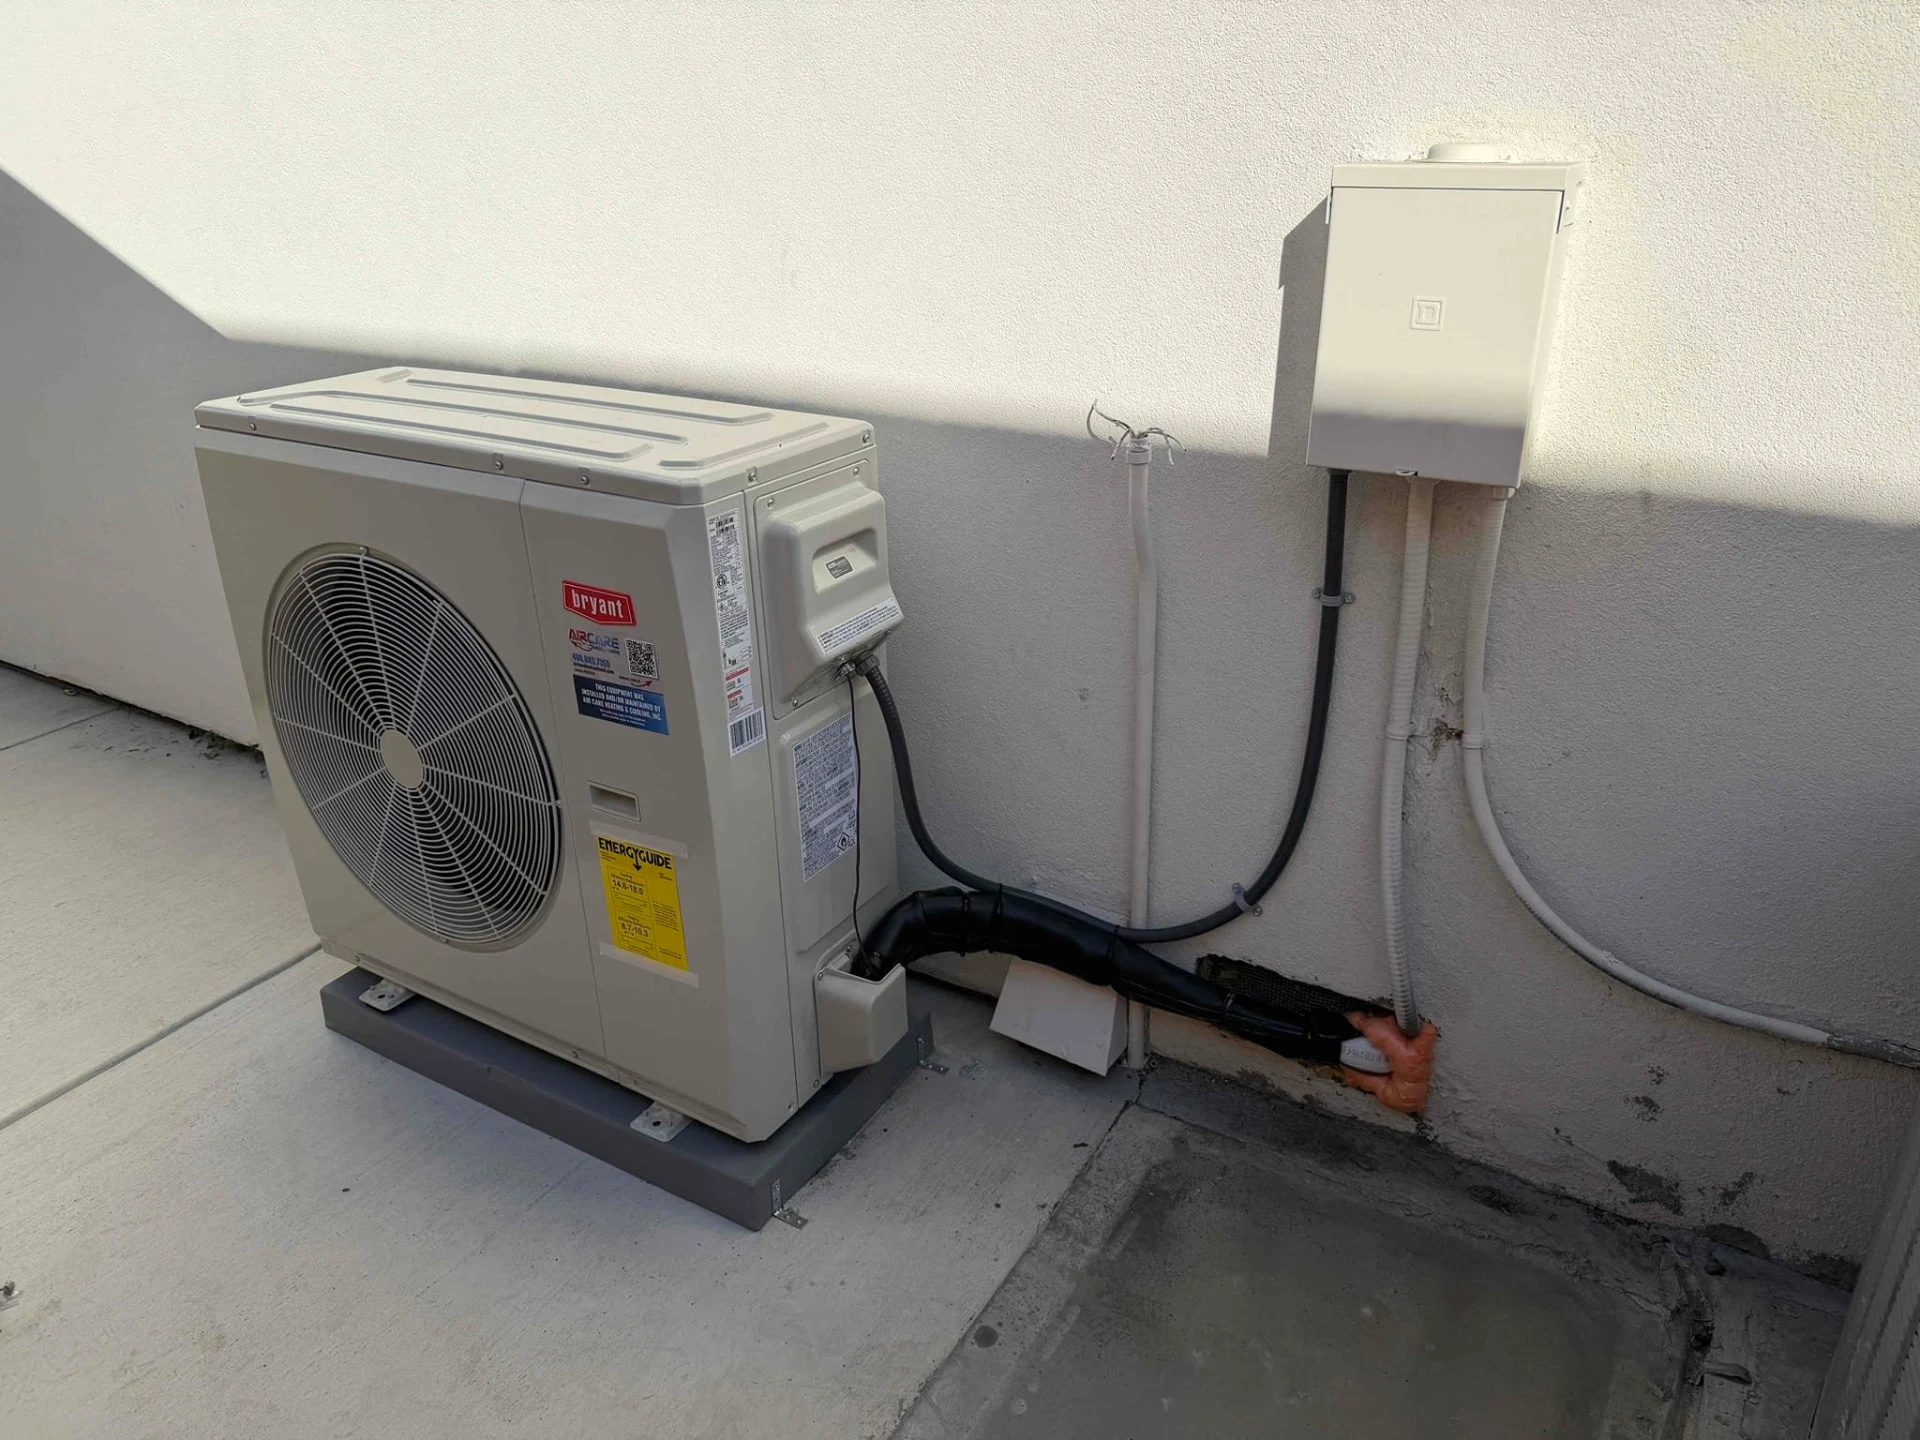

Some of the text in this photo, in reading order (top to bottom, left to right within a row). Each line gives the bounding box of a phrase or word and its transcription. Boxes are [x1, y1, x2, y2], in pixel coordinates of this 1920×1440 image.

[572, 589, 624, 619] bryant
[582, 689, 661, 713] INSTALLED AND/OR MAINTAINED BY
[595, 683, 644, 700] THIS EQUIPMENT WAS
[583, 697, 591, 705] AIR
[592, 699, 604, 708] CARE
[605, 701, 624, 712] HEATING
[598, 837, 673, 870] ENERGYGUIDE
